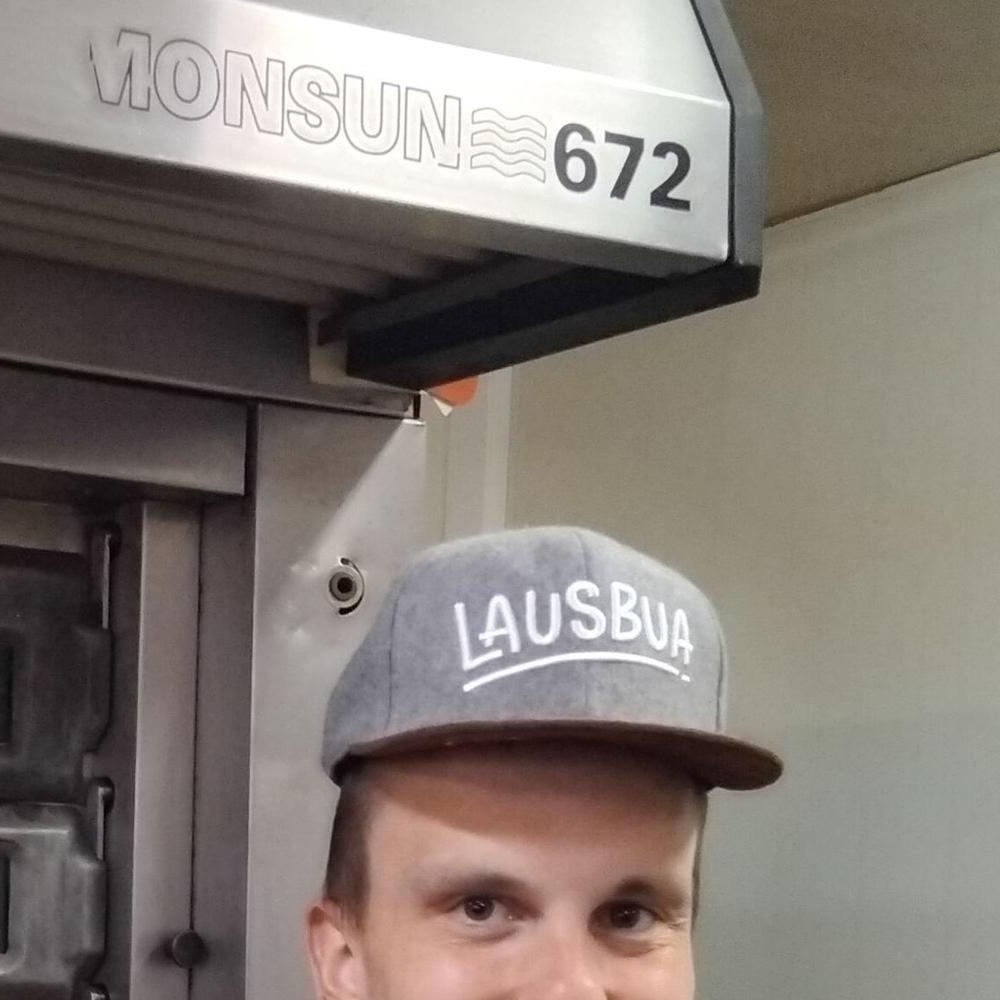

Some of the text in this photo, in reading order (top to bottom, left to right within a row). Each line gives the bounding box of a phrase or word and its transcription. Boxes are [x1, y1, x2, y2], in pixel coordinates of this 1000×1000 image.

[89, 28, 692, 212] MONSUN 672
[453, 579, 695, 672] LAUSBUA
